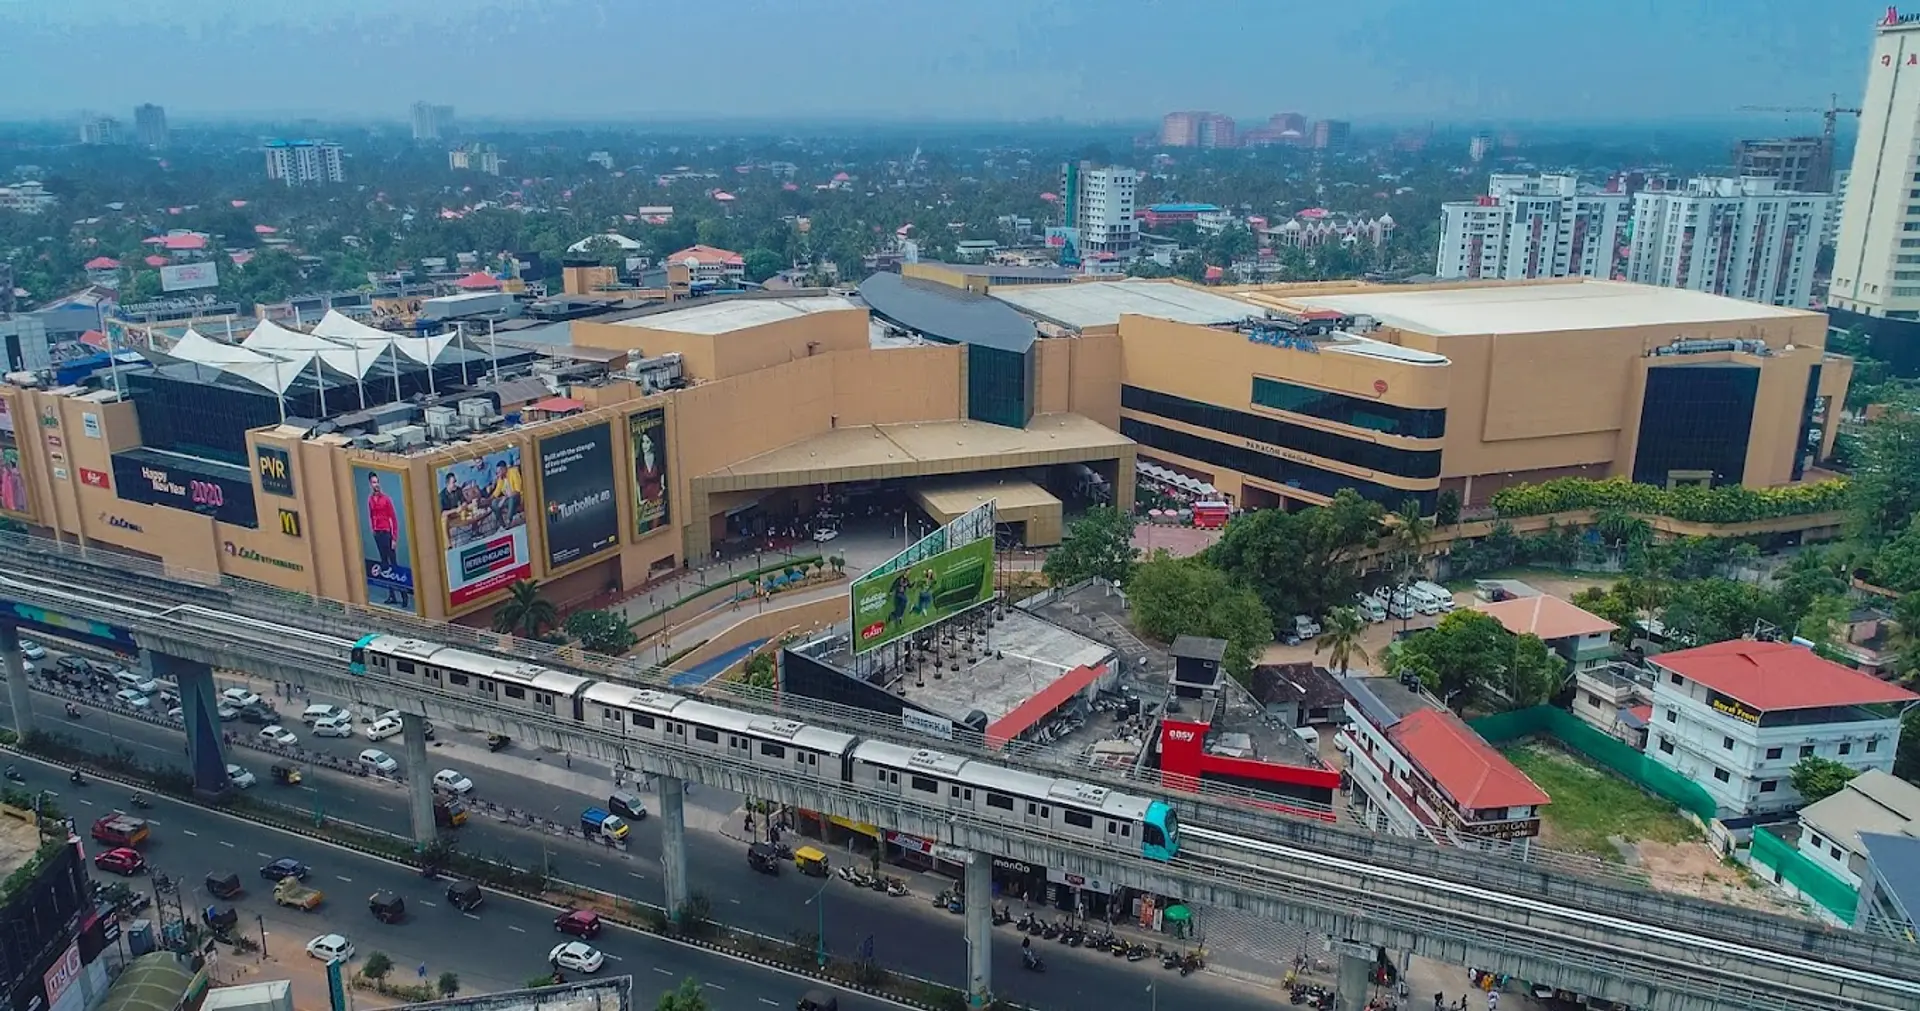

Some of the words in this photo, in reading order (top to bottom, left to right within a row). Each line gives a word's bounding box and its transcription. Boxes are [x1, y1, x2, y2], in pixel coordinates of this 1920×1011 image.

[141, 466, 167, 483] Happy
[260, 455, 286, 480] PVR
[190, 480, 224, 507] 2020
[558, 493, 600, 519] TurboNet
[1169, 730, 1195, 742] easy
